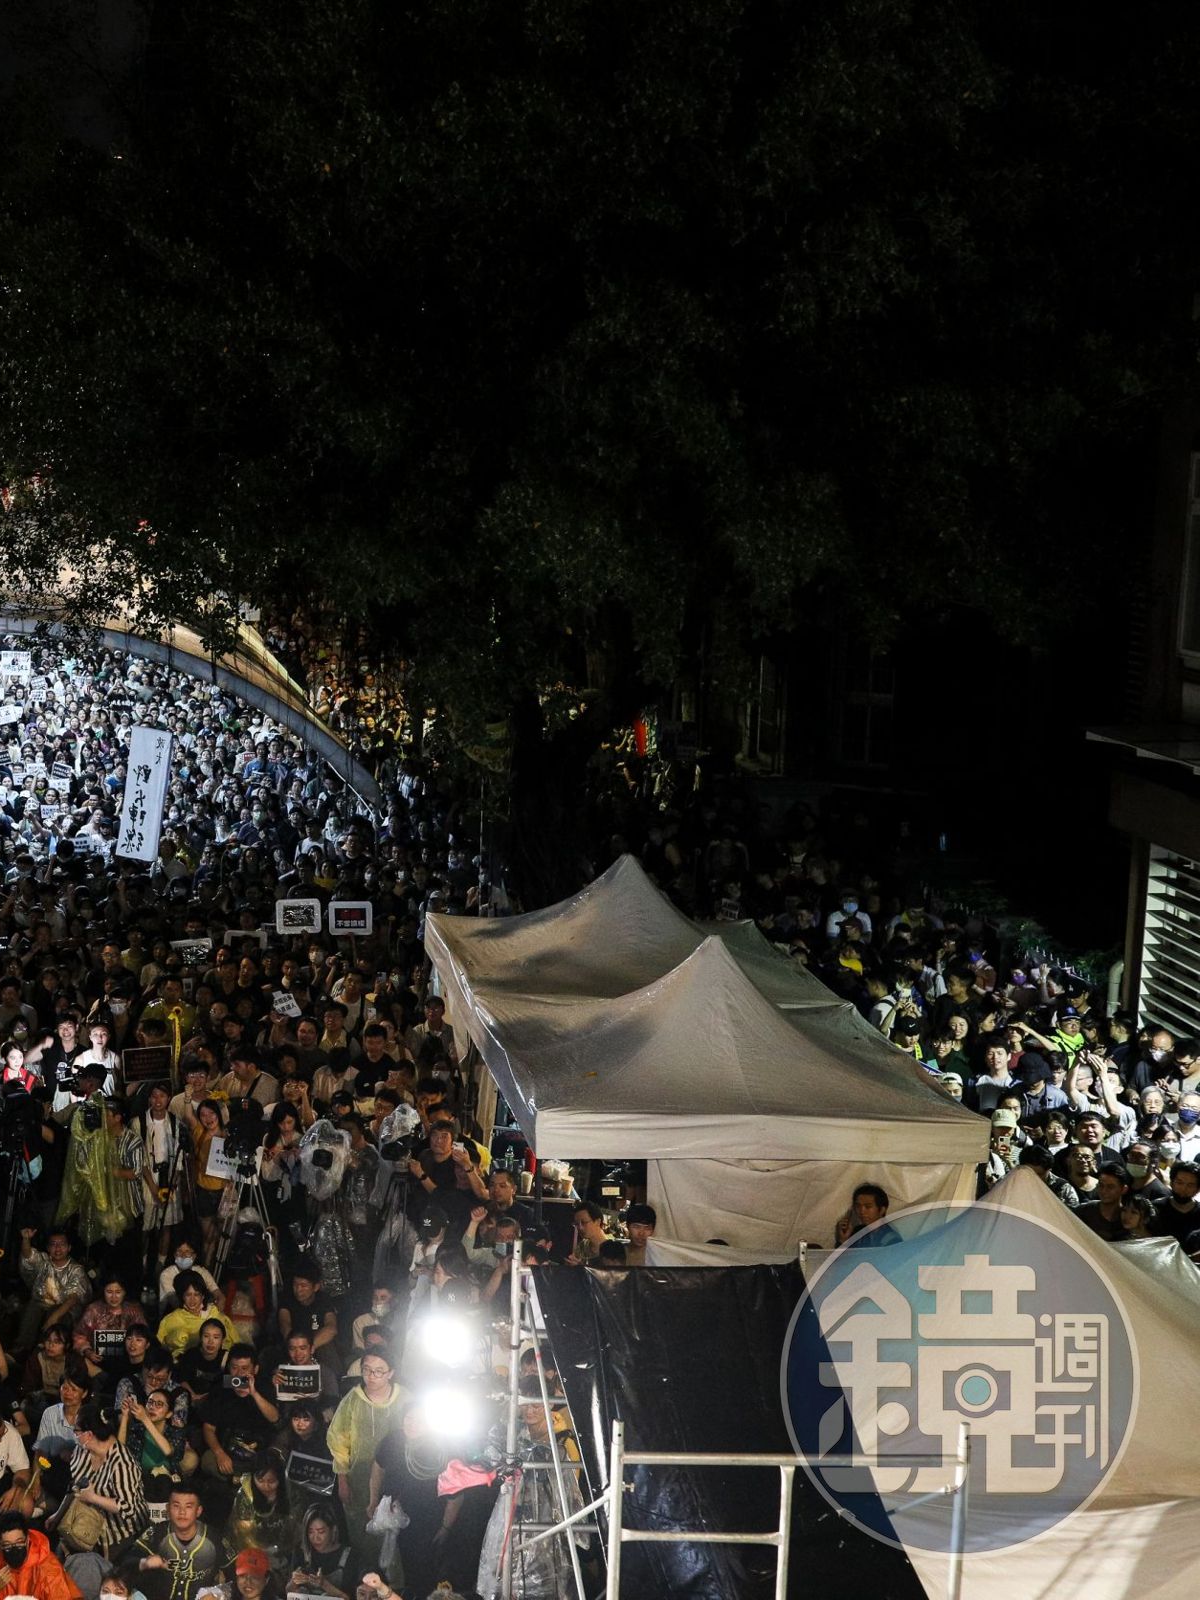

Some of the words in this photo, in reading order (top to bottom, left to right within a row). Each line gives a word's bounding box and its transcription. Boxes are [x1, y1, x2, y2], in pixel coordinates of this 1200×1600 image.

[98, 1333, 126, 1343] 公開法
[148, 1509, 167, 1518] 國會
